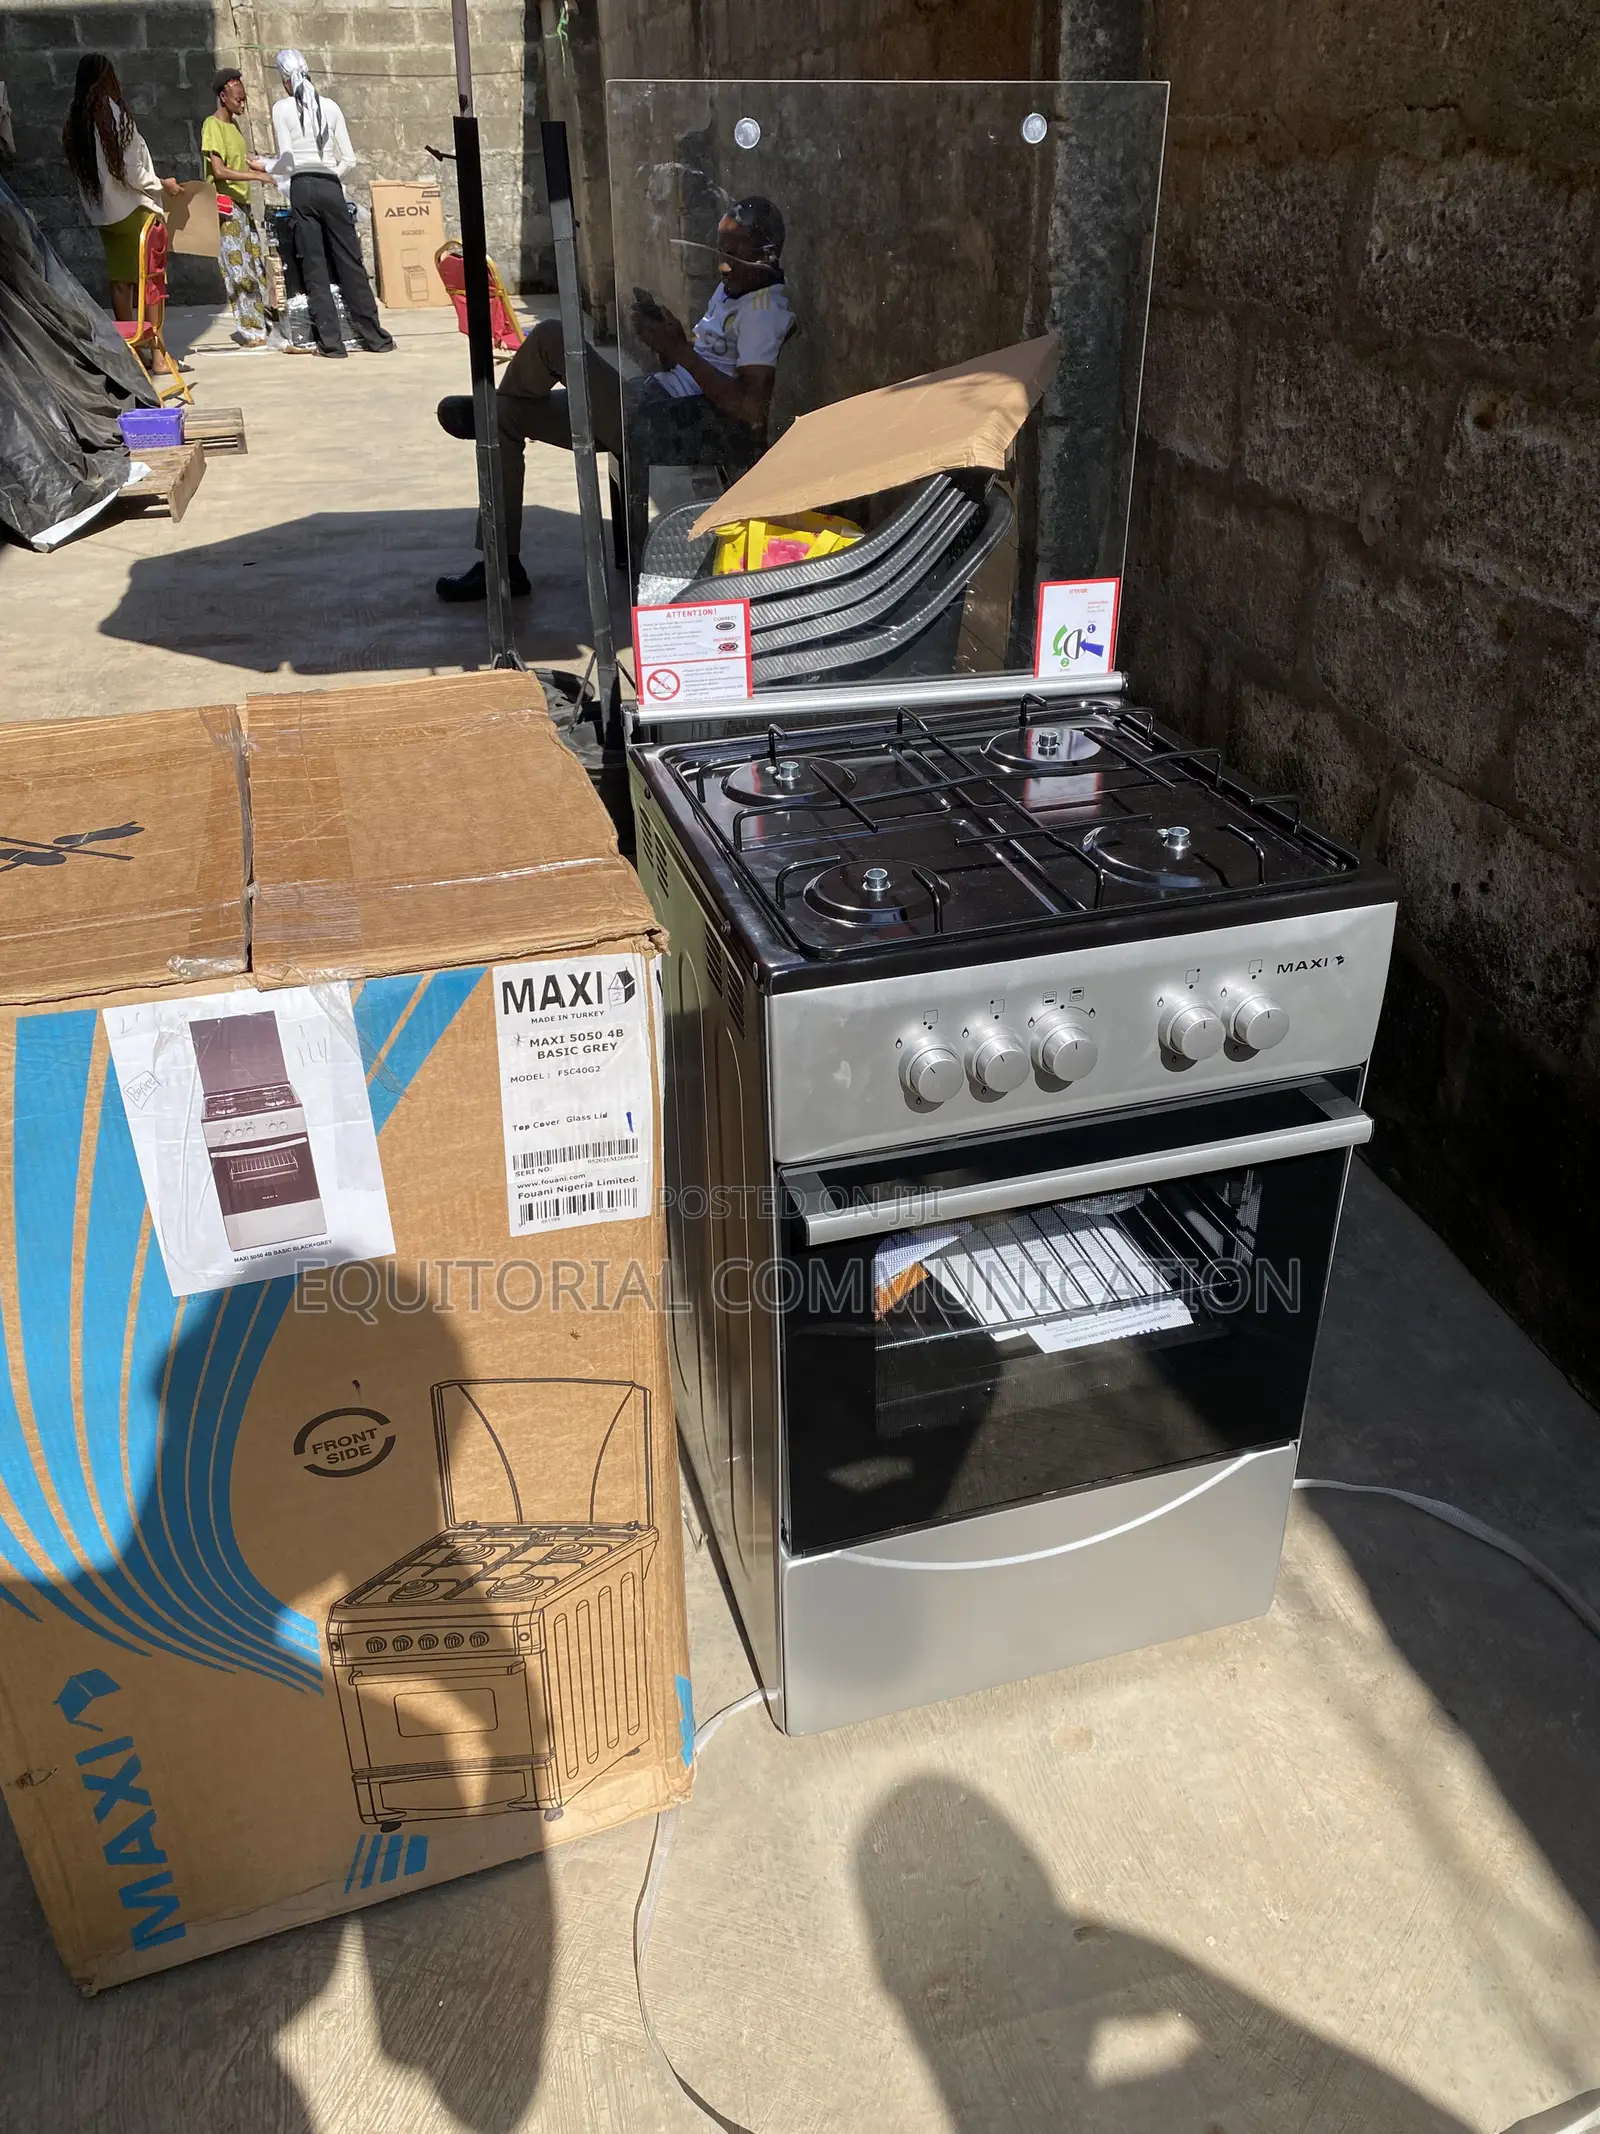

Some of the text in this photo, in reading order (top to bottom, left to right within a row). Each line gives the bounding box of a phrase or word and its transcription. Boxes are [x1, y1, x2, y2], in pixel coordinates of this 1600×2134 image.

[385, 205, 430, 218] AEON
[666, 608, 717, 619] ATTENTION!
[1277, 958, 1328, 974] MAXI
[502, 971, 603, 1015] MAXI
[531, 1016, 555, 1024] MADE
[571, 1010, 605, 1020] TURKEY
[530, 1029, 624, 1048] MAXI 5050 4B
[537, 1042, 618, 1060] BASIC GREY
[510, 1073, 545, 1083] MODEL
[512, 1112, 608, 1132] Top Cover Glass Lid
[515, 1169, 535, 1178] SERI
[517, 1173, 586, 1189] www.fouani.com
[518, 1175, 639, 1200] Fouani Nigeria Limited.
[250, 1252, 264, 1260] 5050
[273, 1247, 292, 1256] BASIC
[292, 1239, 333, 1252] BLACK+GREY
[312, 1428, 378, 1455] FRONT
[326, 1443, 373, 1465] SIDE
[75, 1735, 187, 1951] MAXI
